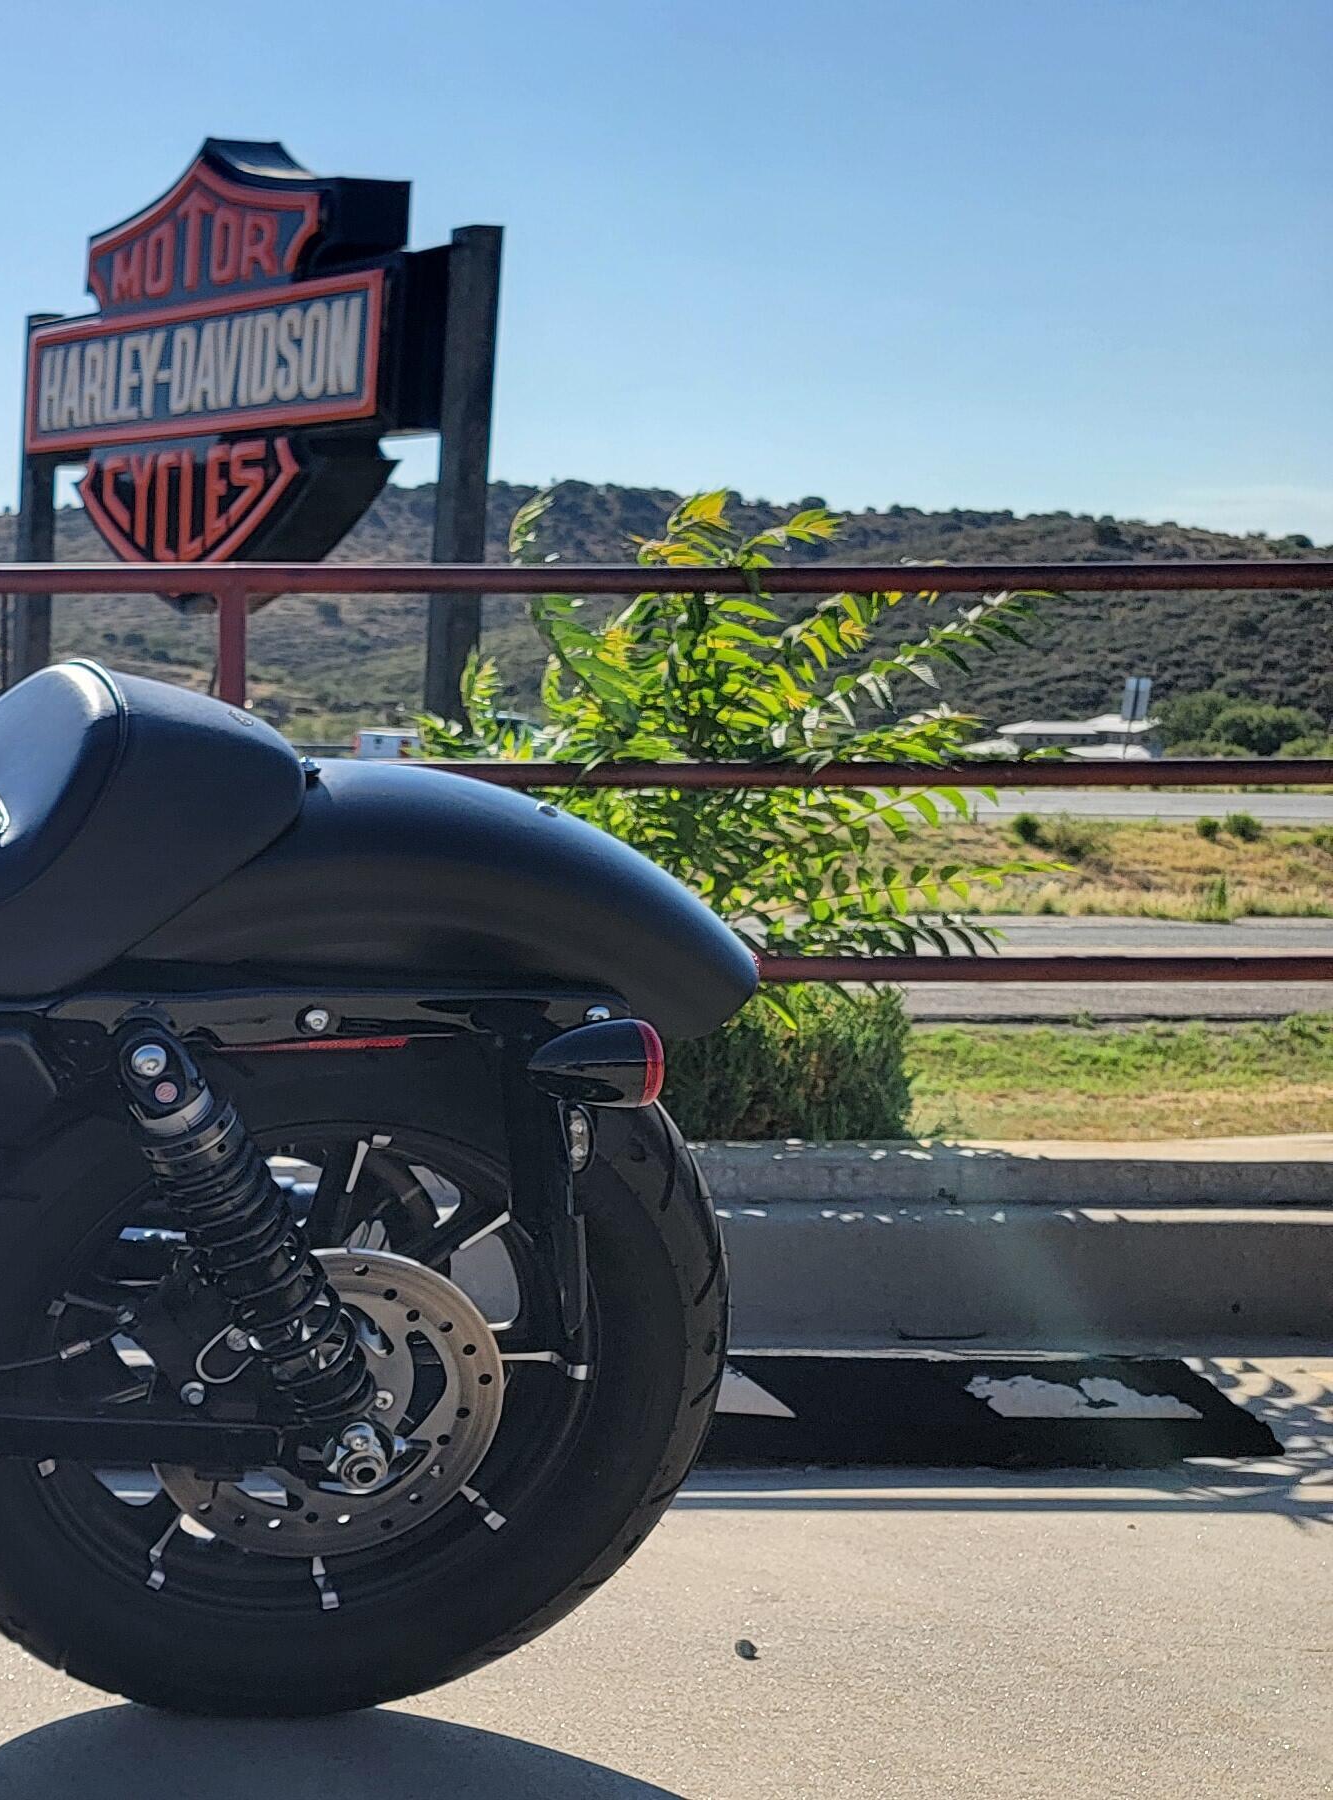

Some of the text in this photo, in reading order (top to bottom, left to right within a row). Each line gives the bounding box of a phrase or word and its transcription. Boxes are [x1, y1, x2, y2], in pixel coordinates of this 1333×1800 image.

[110, 191, 279, 304] MOTOR
[38, 297, 363, 432] HARLEY-DAVIDSON
[103, 438, 267, 563] CYCLES
